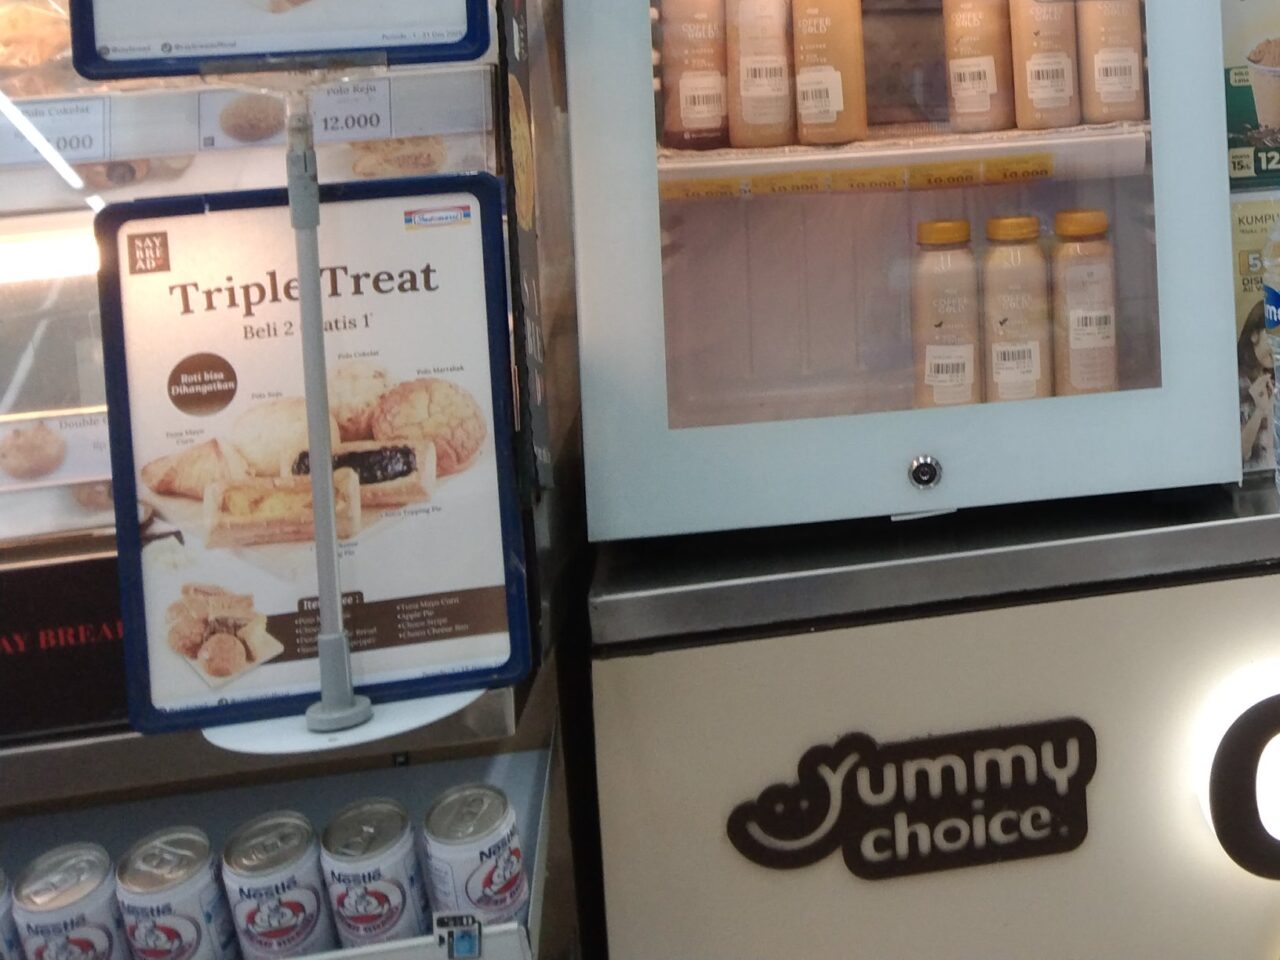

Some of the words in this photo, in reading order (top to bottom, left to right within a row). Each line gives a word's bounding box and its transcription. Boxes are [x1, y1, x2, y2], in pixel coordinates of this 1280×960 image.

[352, 84, 377, 96] Keju
[322, 112, 381, 132] 12.000
[169, 267, 300, 317] Triple
[319, 261, 440, 298] Treat
[242, 324, 278, 341] Beli
[283, 322, 295, 338] 2
[324, 316, 355, 333] atis
[180, 374, 205, 385] Roti
[206, 372, 225, 384] bisa
[171, 382, 236, 397] Dihangatkan
[59, 417, 99, 430] Double
